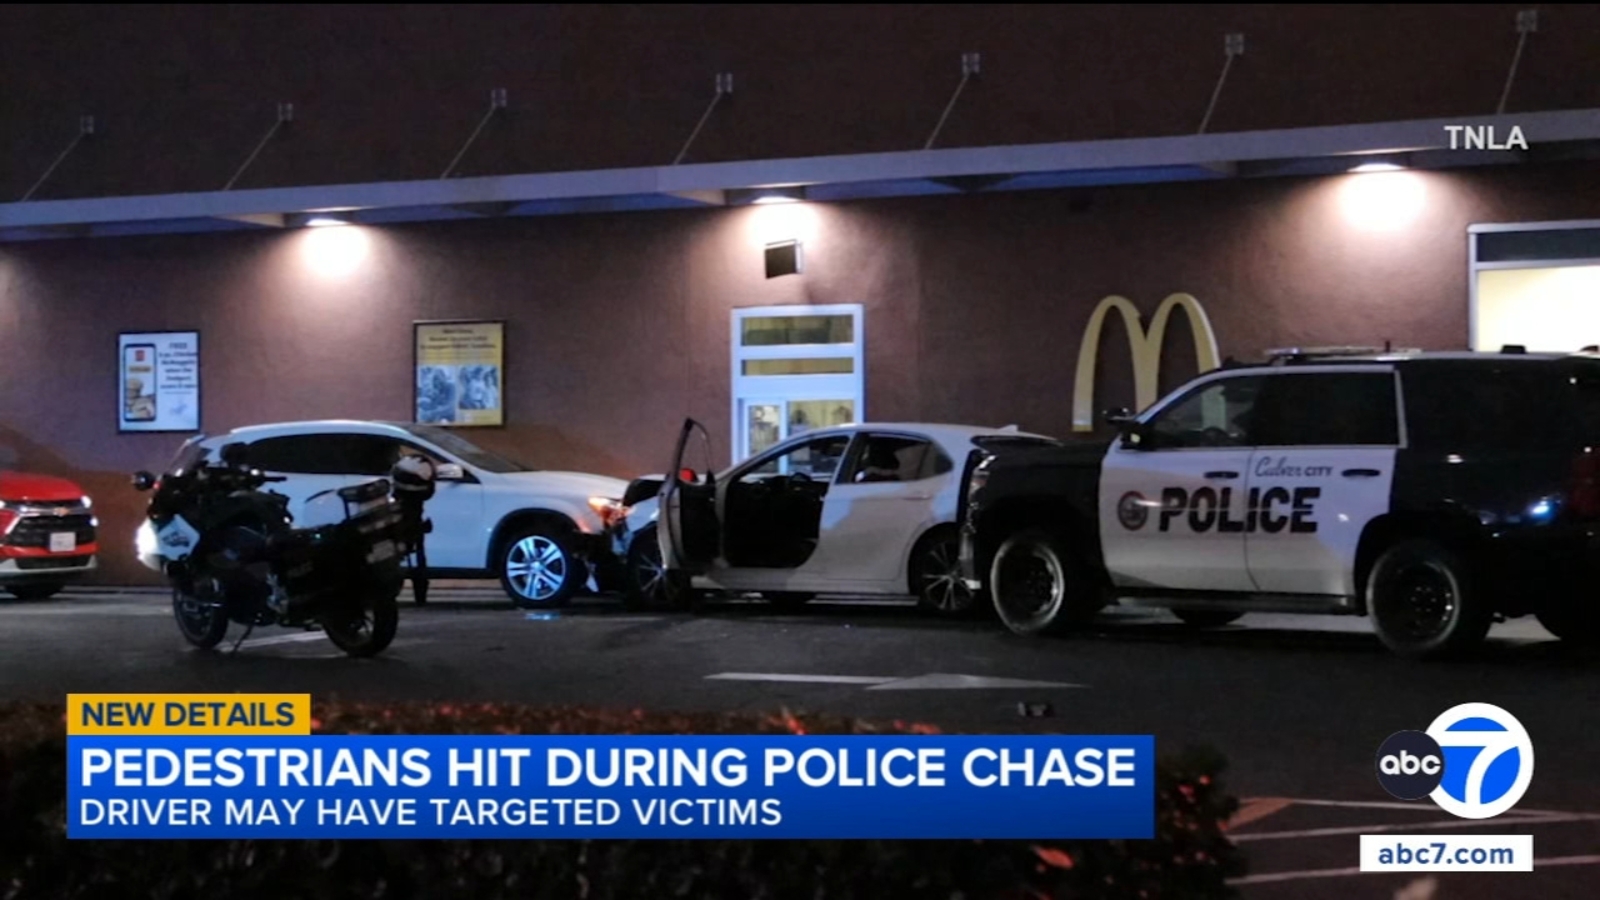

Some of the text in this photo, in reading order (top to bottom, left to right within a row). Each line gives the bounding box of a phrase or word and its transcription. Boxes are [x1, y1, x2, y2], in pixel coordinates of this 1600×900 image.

[1255, 456, 1334, 478] Culver CITY
[1158, 486, 1321, 533] POLICE
